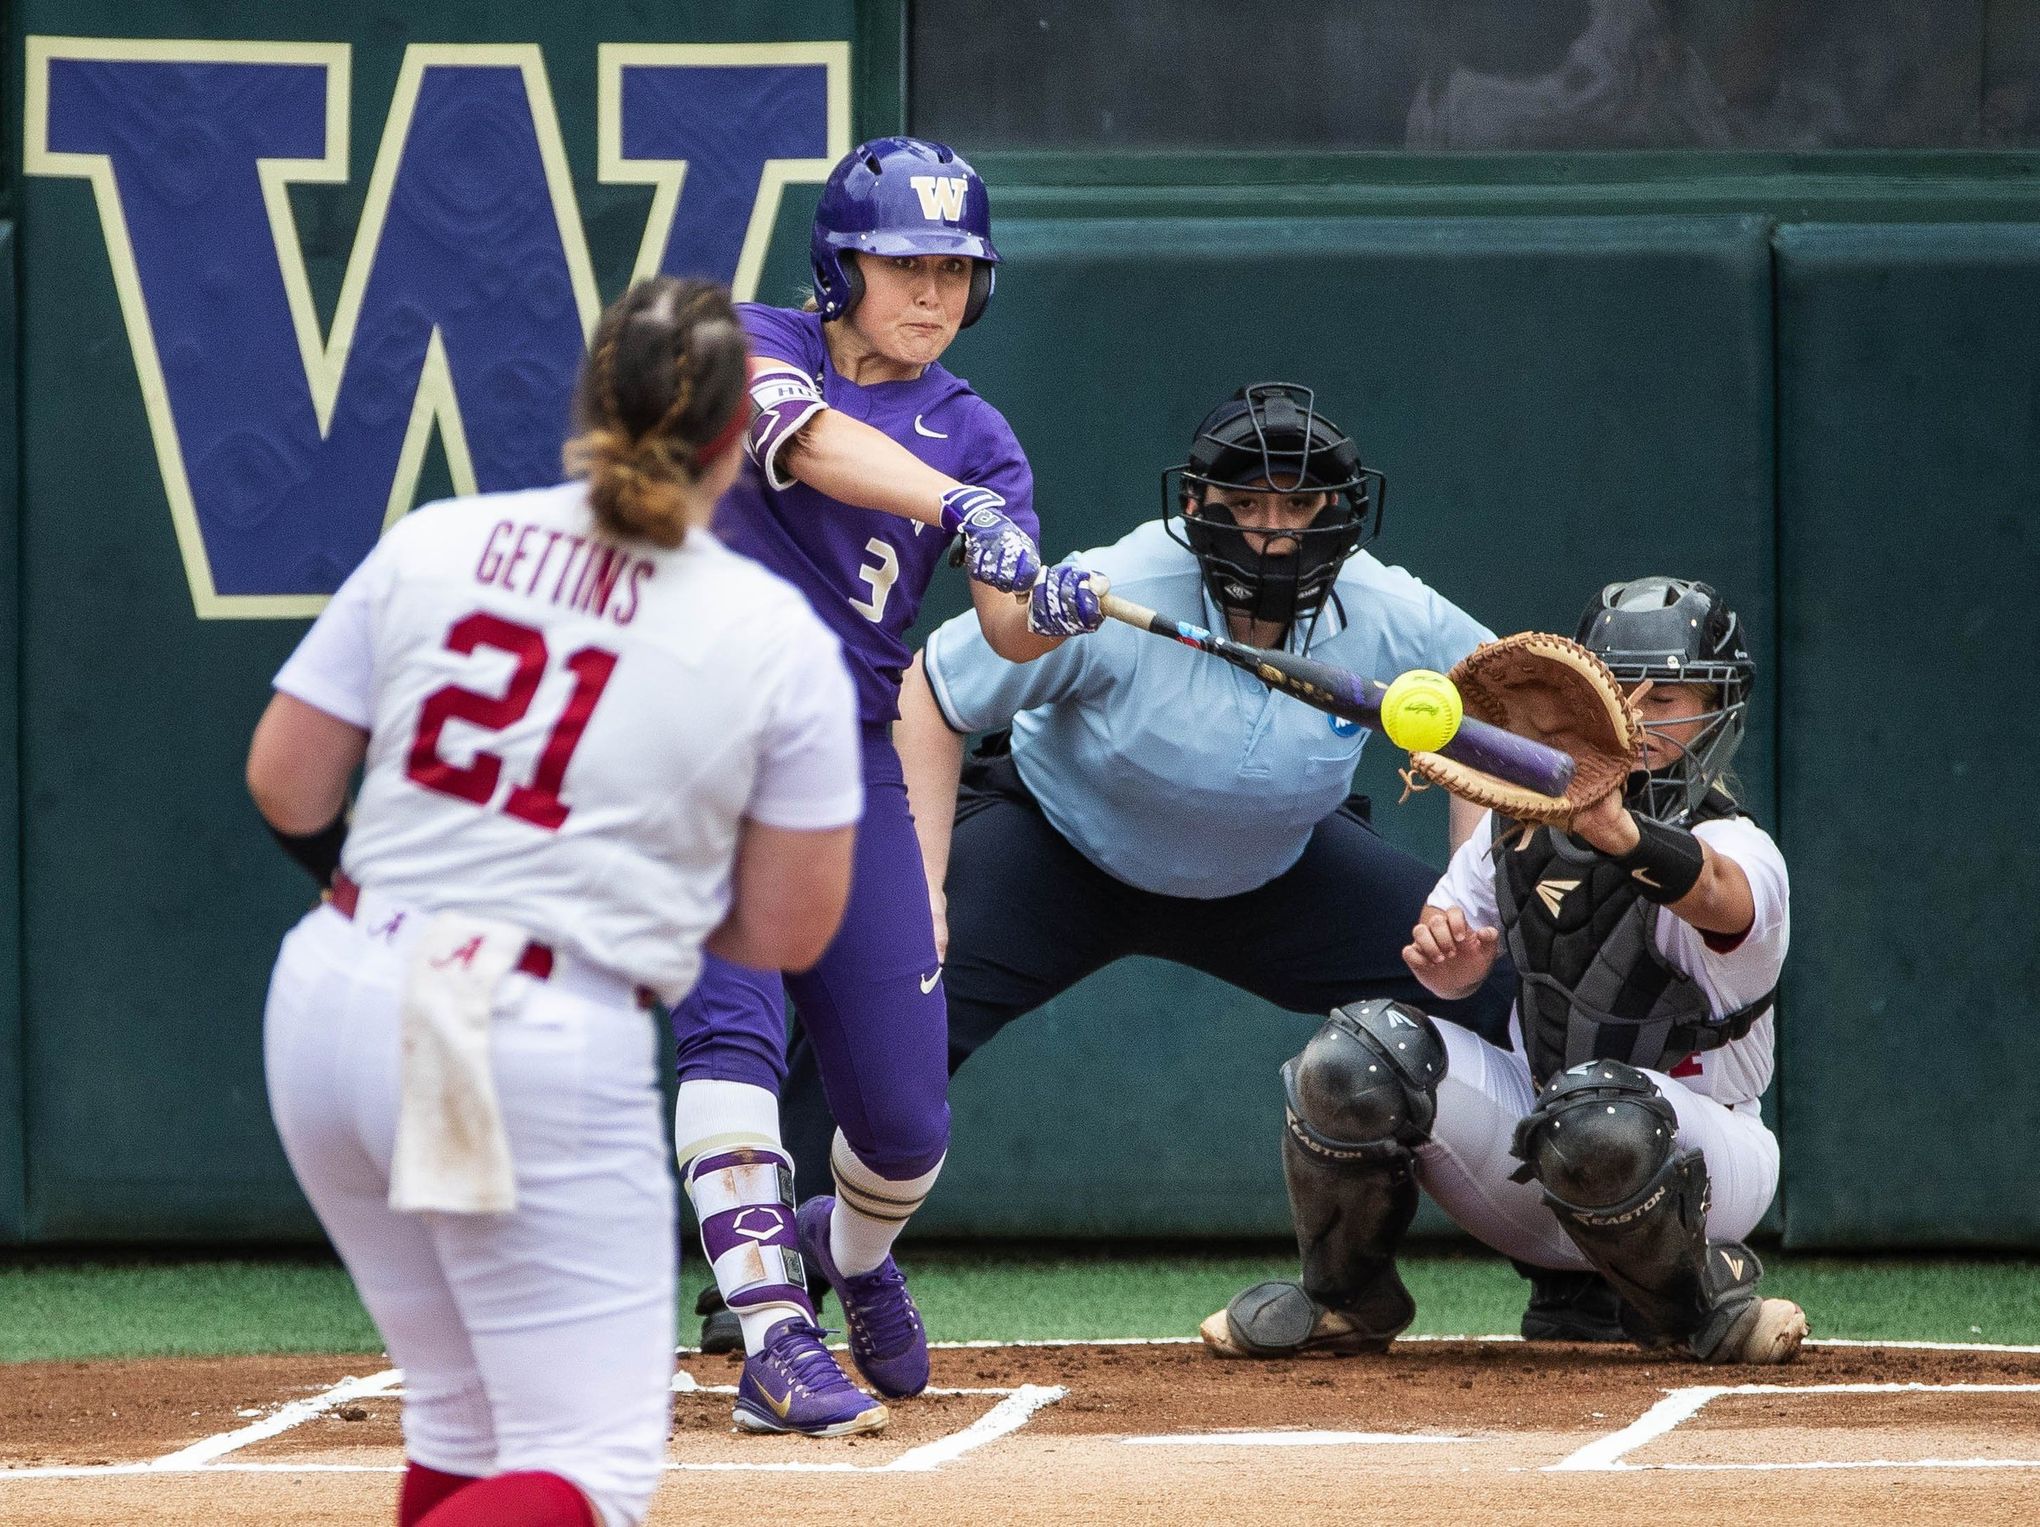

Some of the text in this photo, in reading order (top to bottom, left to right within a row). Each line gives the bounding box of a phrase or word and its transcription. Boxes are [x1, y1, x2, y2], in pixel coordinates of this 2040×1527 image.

[910, 176, 968, 221] W
[24, 36, 851, 619] W
[476, 519, 655, 626] GETTINS
[849, 537, 899, 623] 3
[405, 610, 618, 832] 21
[1590, 1185, 1666, 1226] EASTON
